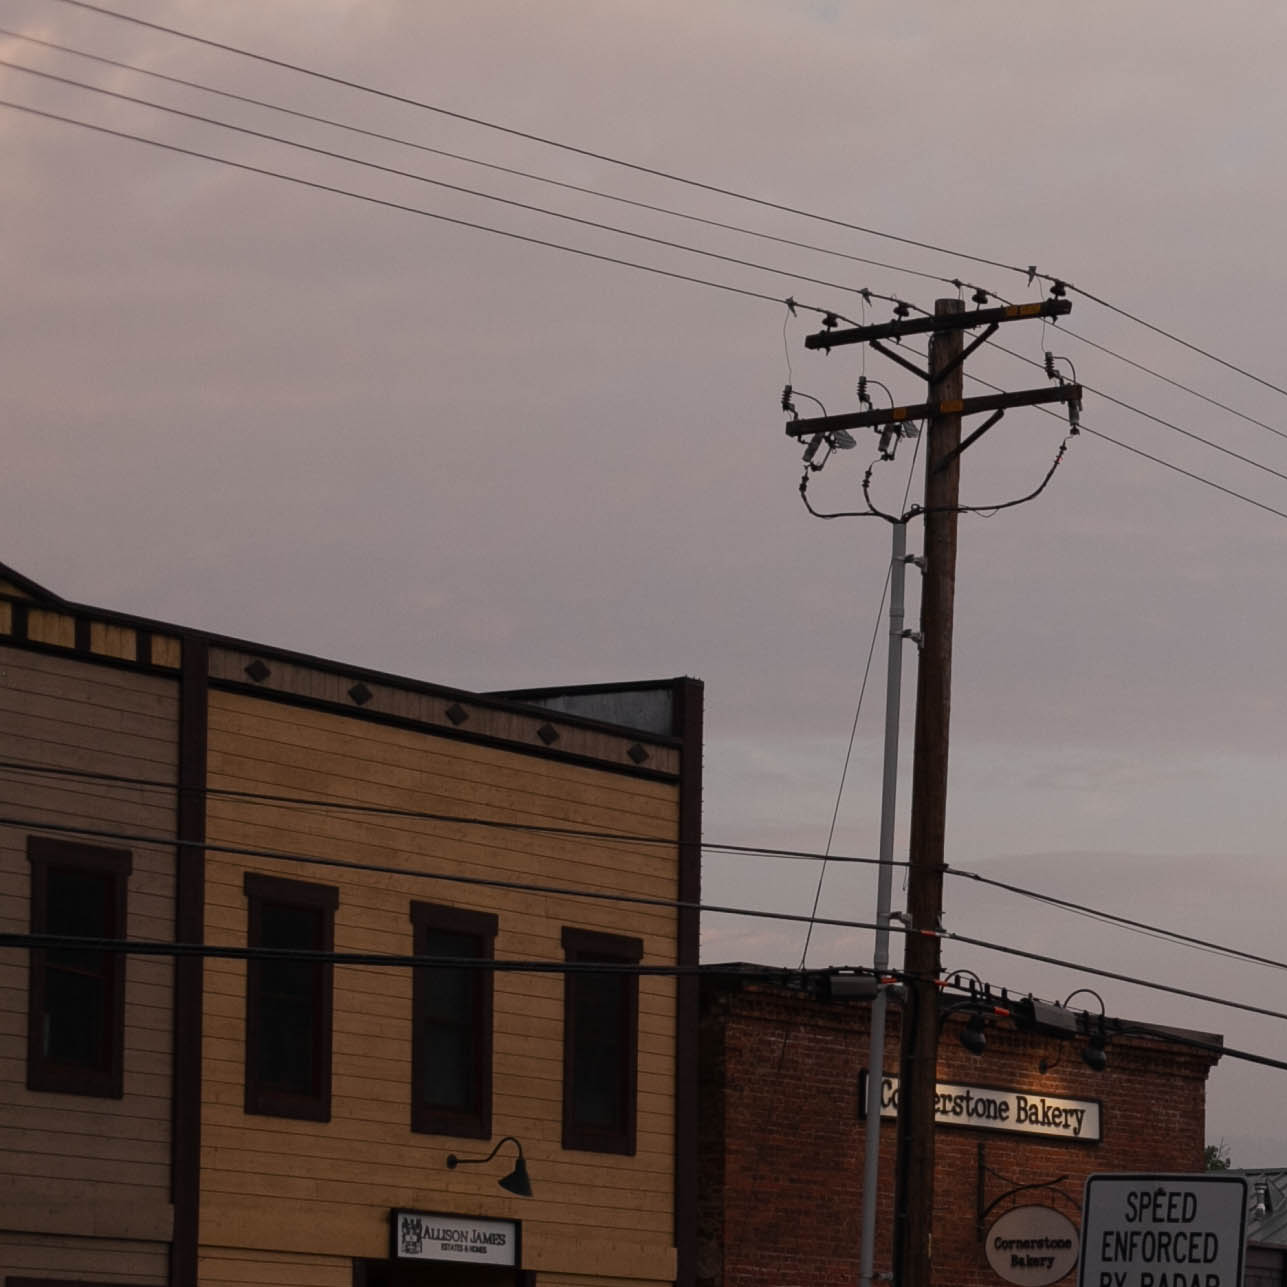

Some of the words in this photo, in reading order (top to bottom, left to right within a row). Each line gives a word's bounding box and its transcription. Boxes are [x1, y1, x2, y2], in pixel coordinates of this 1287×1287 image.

[880, 1079, 1010, 1121] Coerstone
[1016, 1095, 1085, 1135] Bakery
[1125, 1190, 1198, 1223] SPEED
[422, 1225, 469, 1243] ALLISON
[470, 1228, 506, 1246] JAMES
[994, 1236, 1072, 1251] Cornerstone
[1102, 1231, 1218, 1263] ENFORCED
[1010, 1254, 1055, 1270] Bakery
